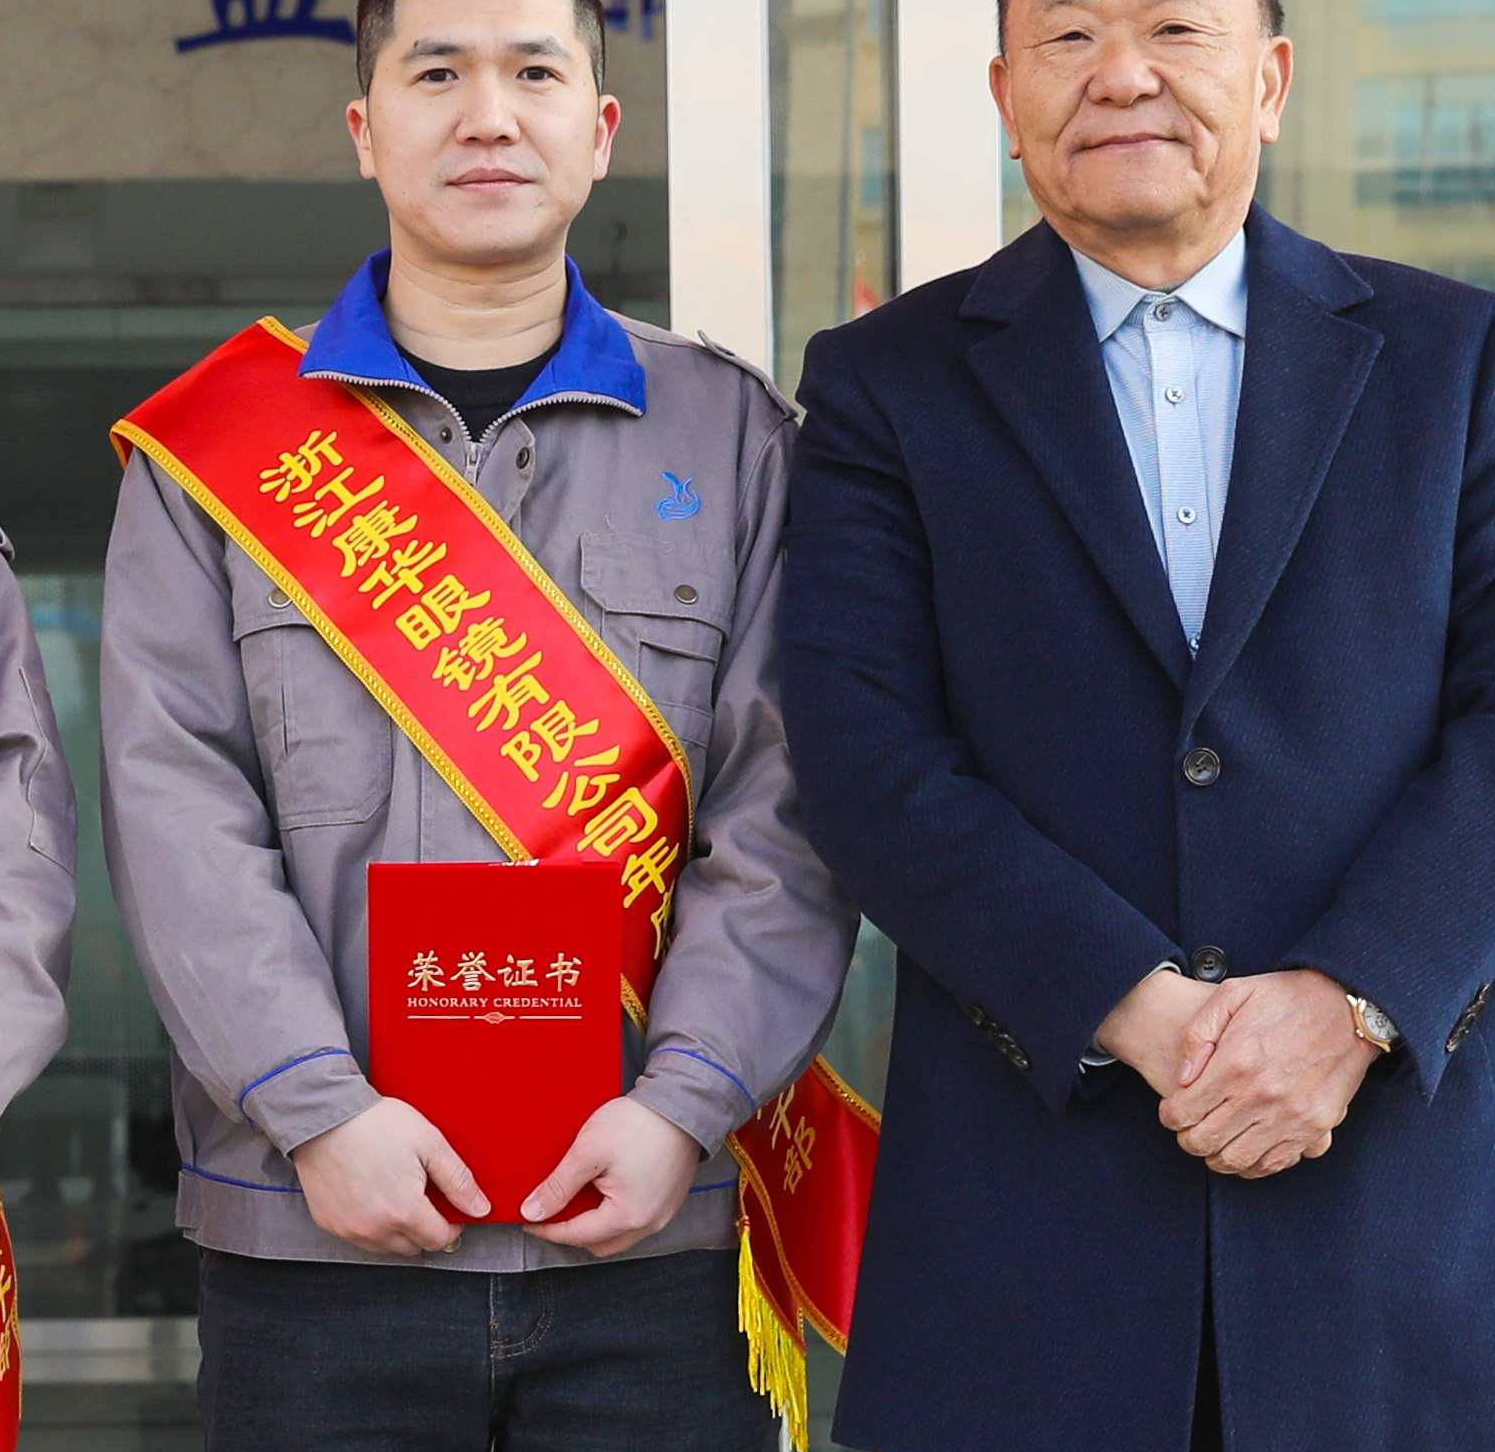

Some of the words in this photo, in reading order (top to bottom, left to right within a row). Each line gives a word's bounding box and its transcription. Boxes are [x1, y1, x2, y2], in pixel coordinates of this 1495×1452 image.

[407, 949, 582, 993] 荣誉证书
[407, 997, 488, 1008] HONORARY
[493, 997, 583, 1008] CREDENTIAL
[756, 1083, 816, 1195] 干部
